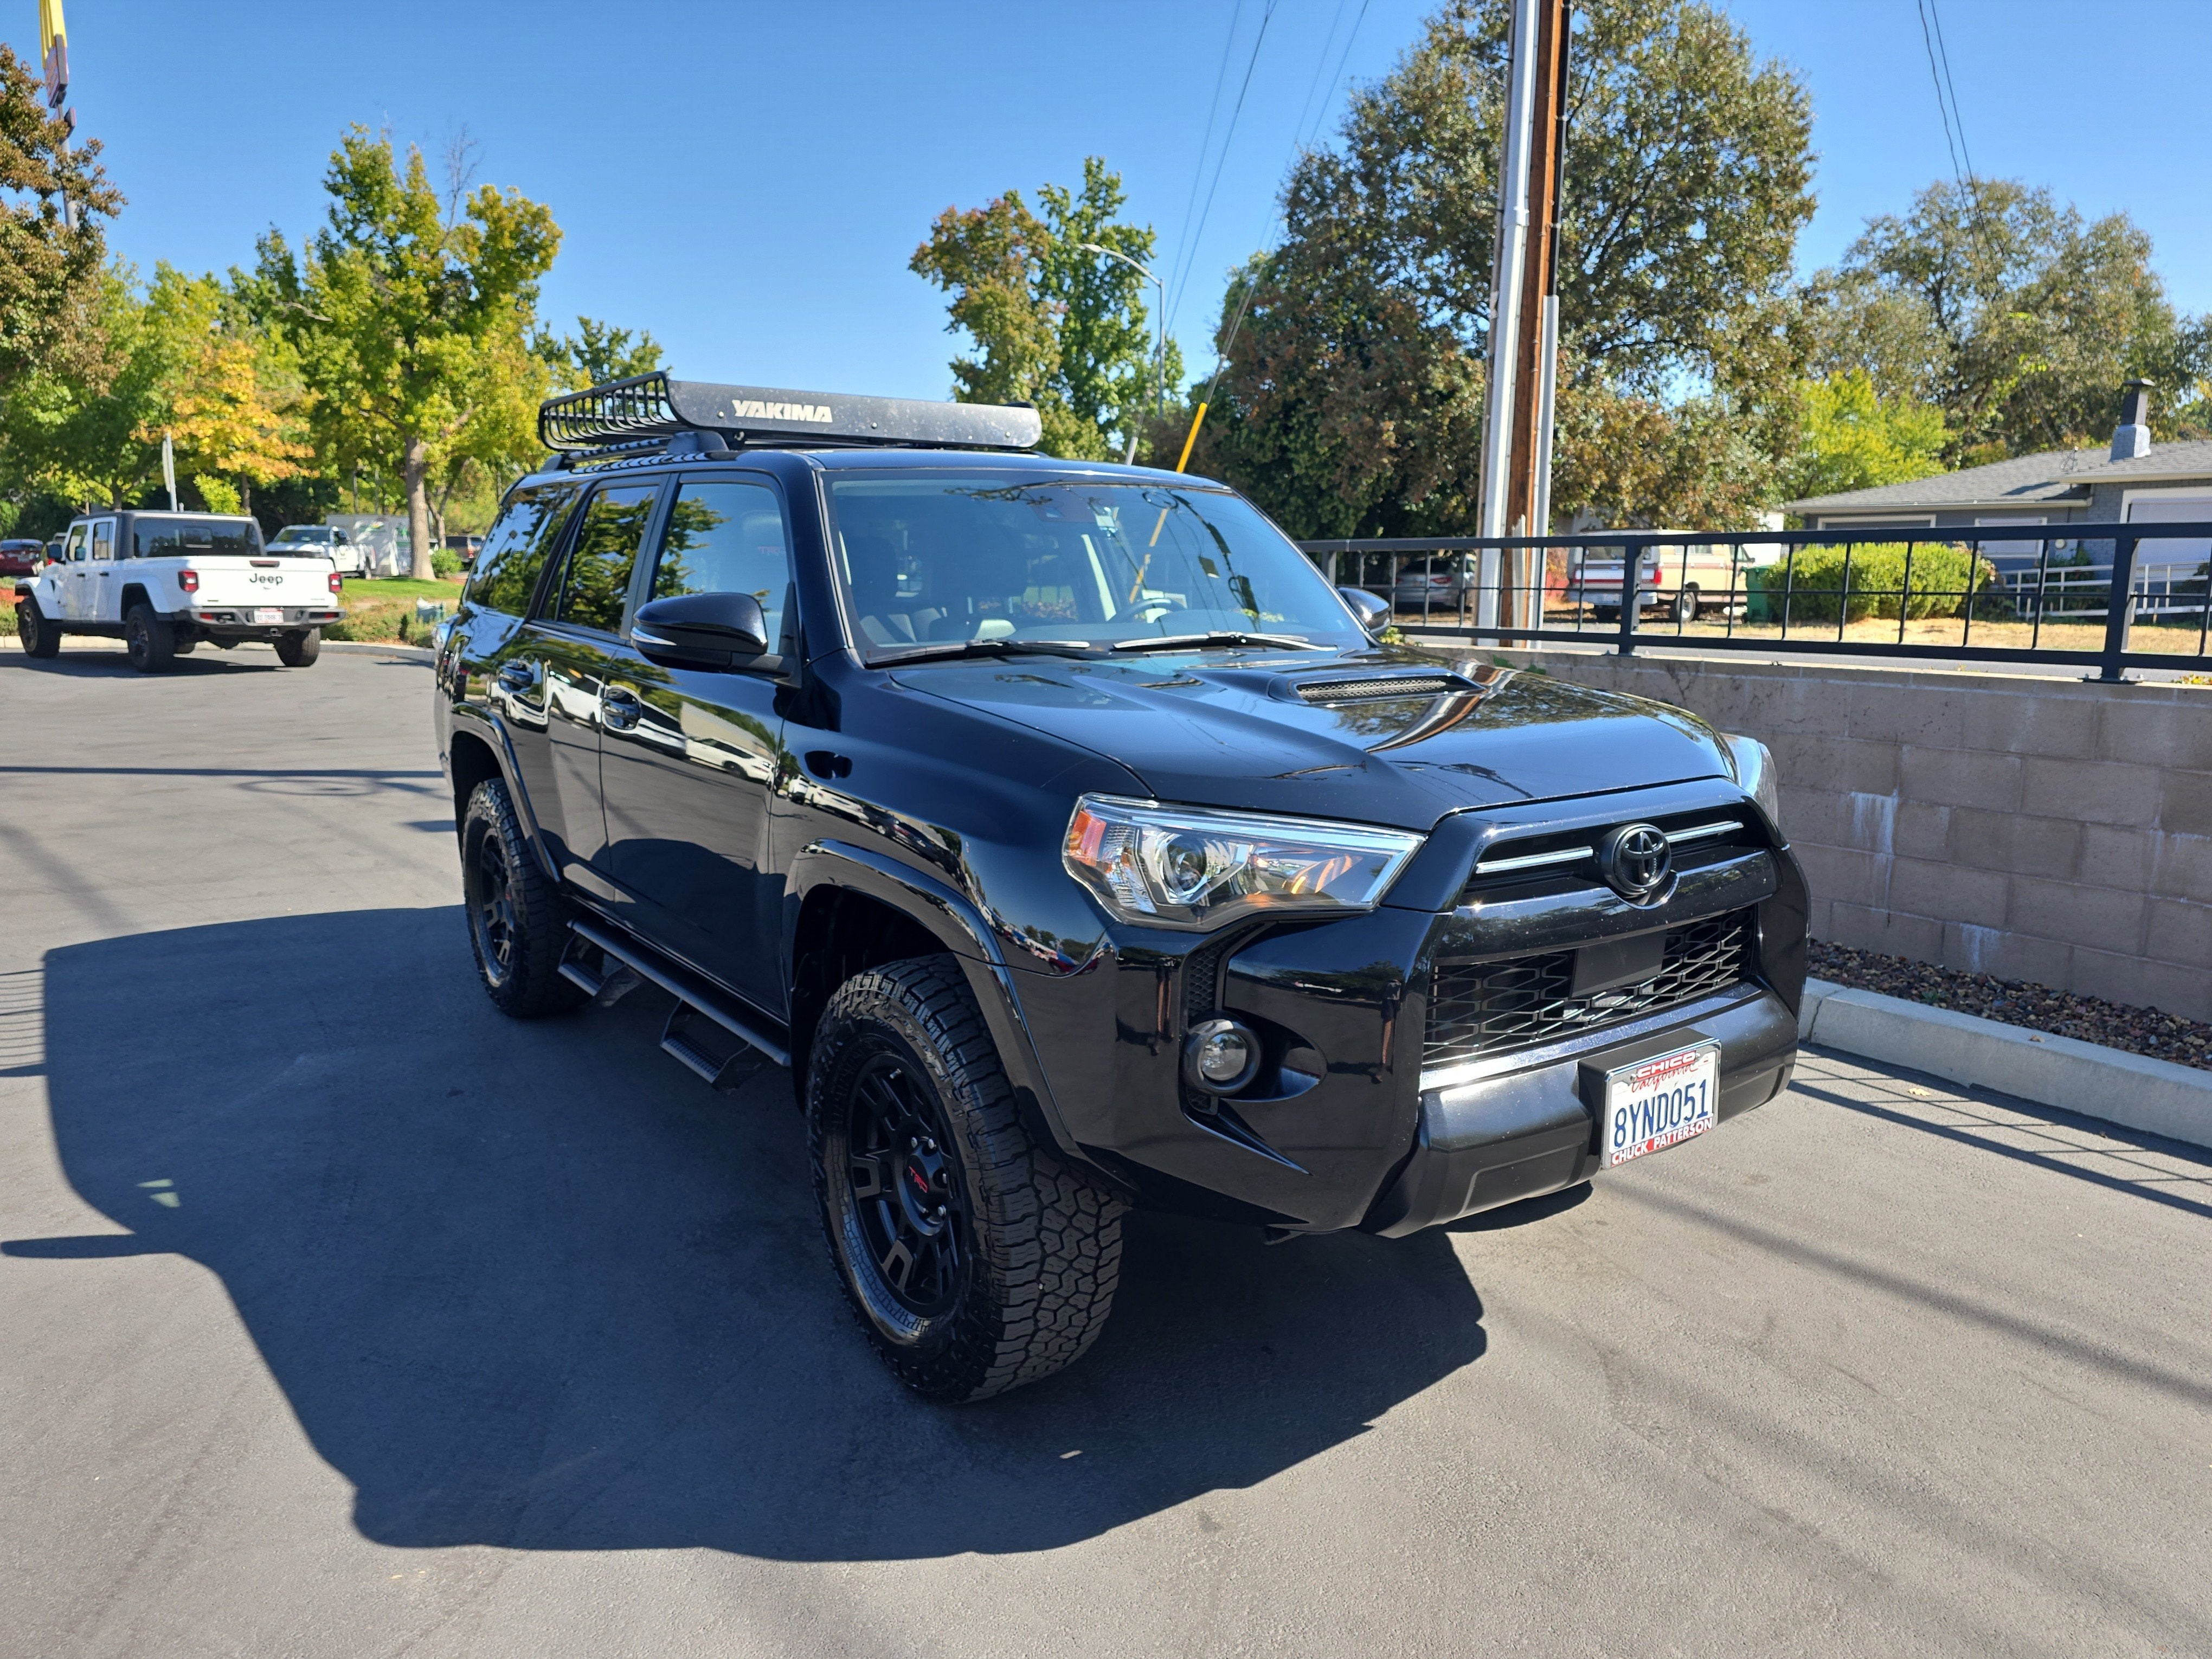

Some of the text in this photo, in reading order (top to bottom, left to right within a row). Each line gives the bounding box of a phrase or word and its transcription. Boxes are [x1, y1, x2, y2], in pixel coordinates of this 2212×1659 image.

[732, 400, 833, 423] YAKIMA
[249, 573, 283, 585] Jeep
[1637, 1051, 1696, 1078] CHICO
[1614, 1079, 1708, 1148] 8YND051
[1612, 1117, 1712, 1165] CHUCK PATTERSON
[909, 1166, 928, 1193] TRD
